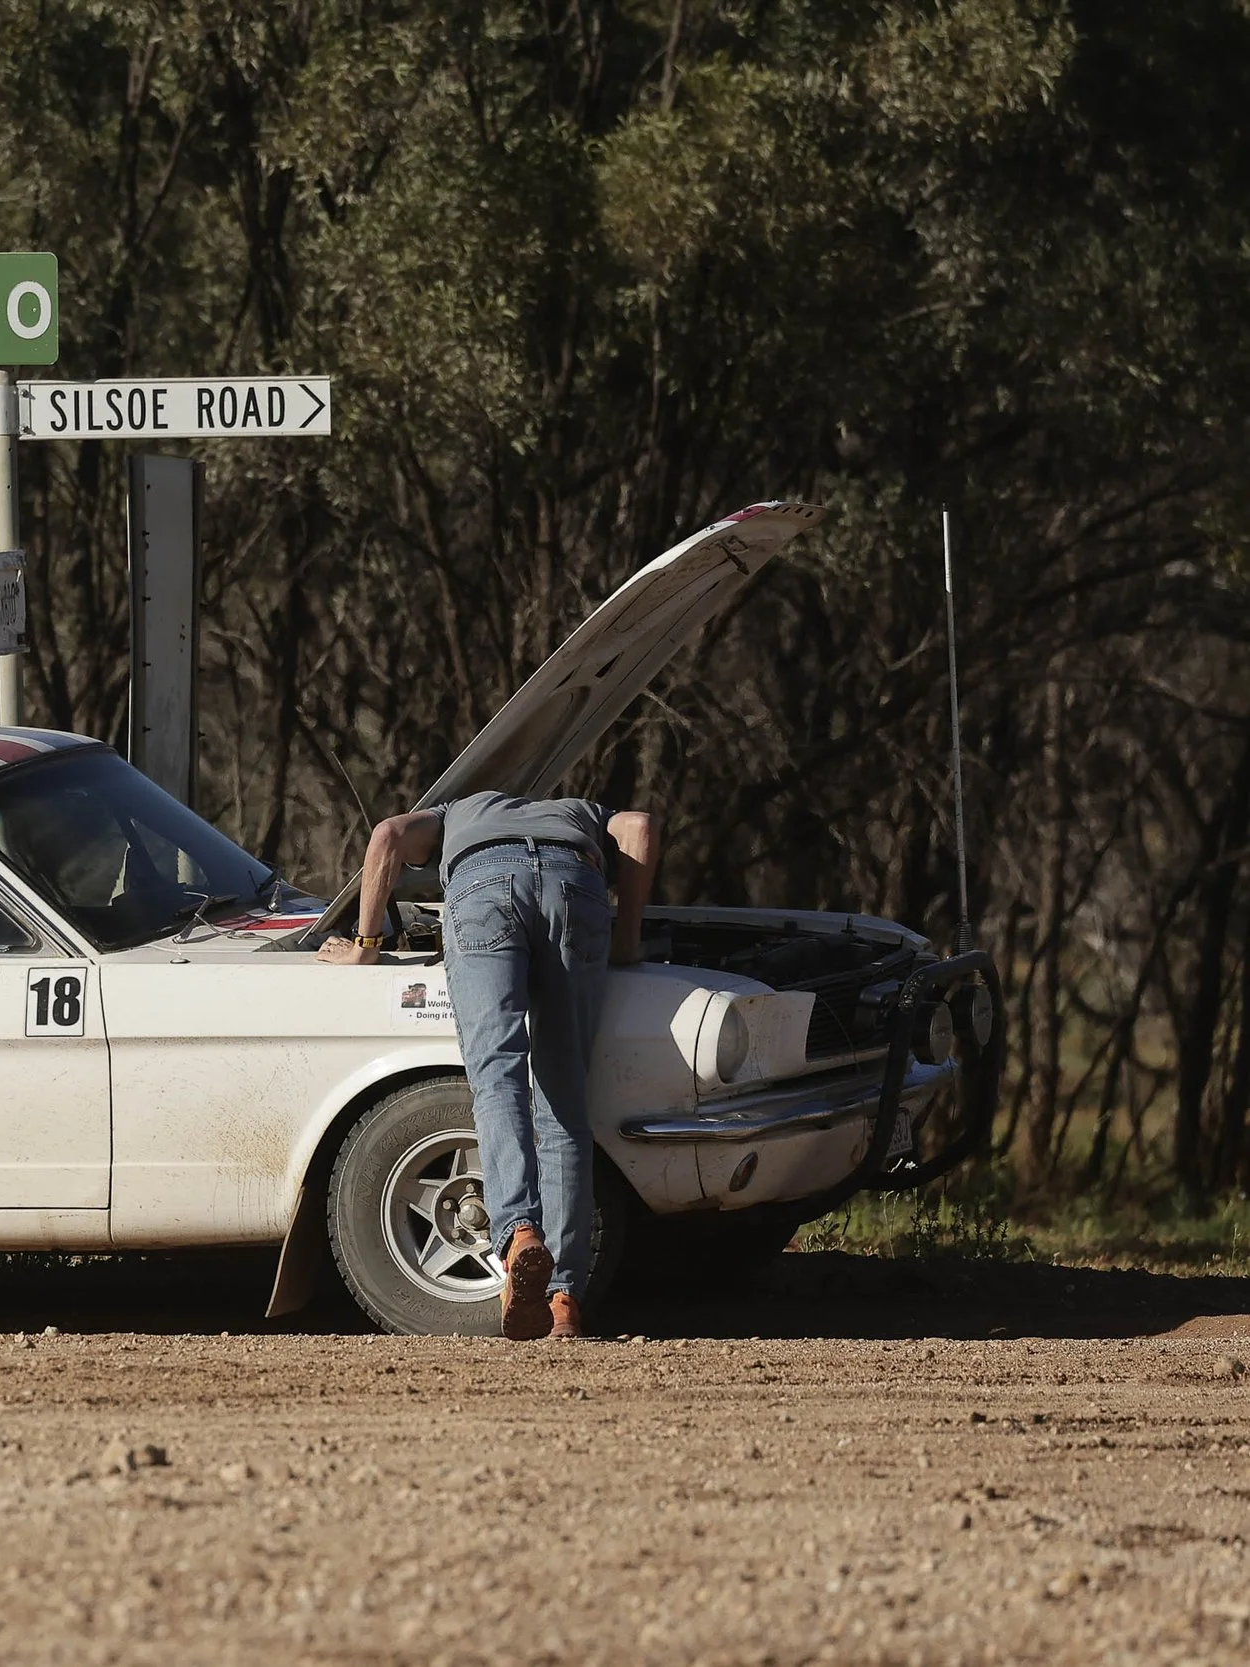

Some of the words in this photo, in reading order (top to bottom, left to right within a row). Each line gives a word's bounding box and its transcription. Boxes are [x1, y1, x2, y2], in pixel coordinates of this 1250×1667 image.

[49, 387, 169, 433] SILSOE
[196, 385, 287, 429] ROAD
[29, 976, 82, 1027] 18
[416, 1011, 441, 1020] Doing
[441, 1011, 448, 1019] it
[427, 1000, 451, 1010] Wolfg
[380, 1103, 474, 1152] 4X4W
